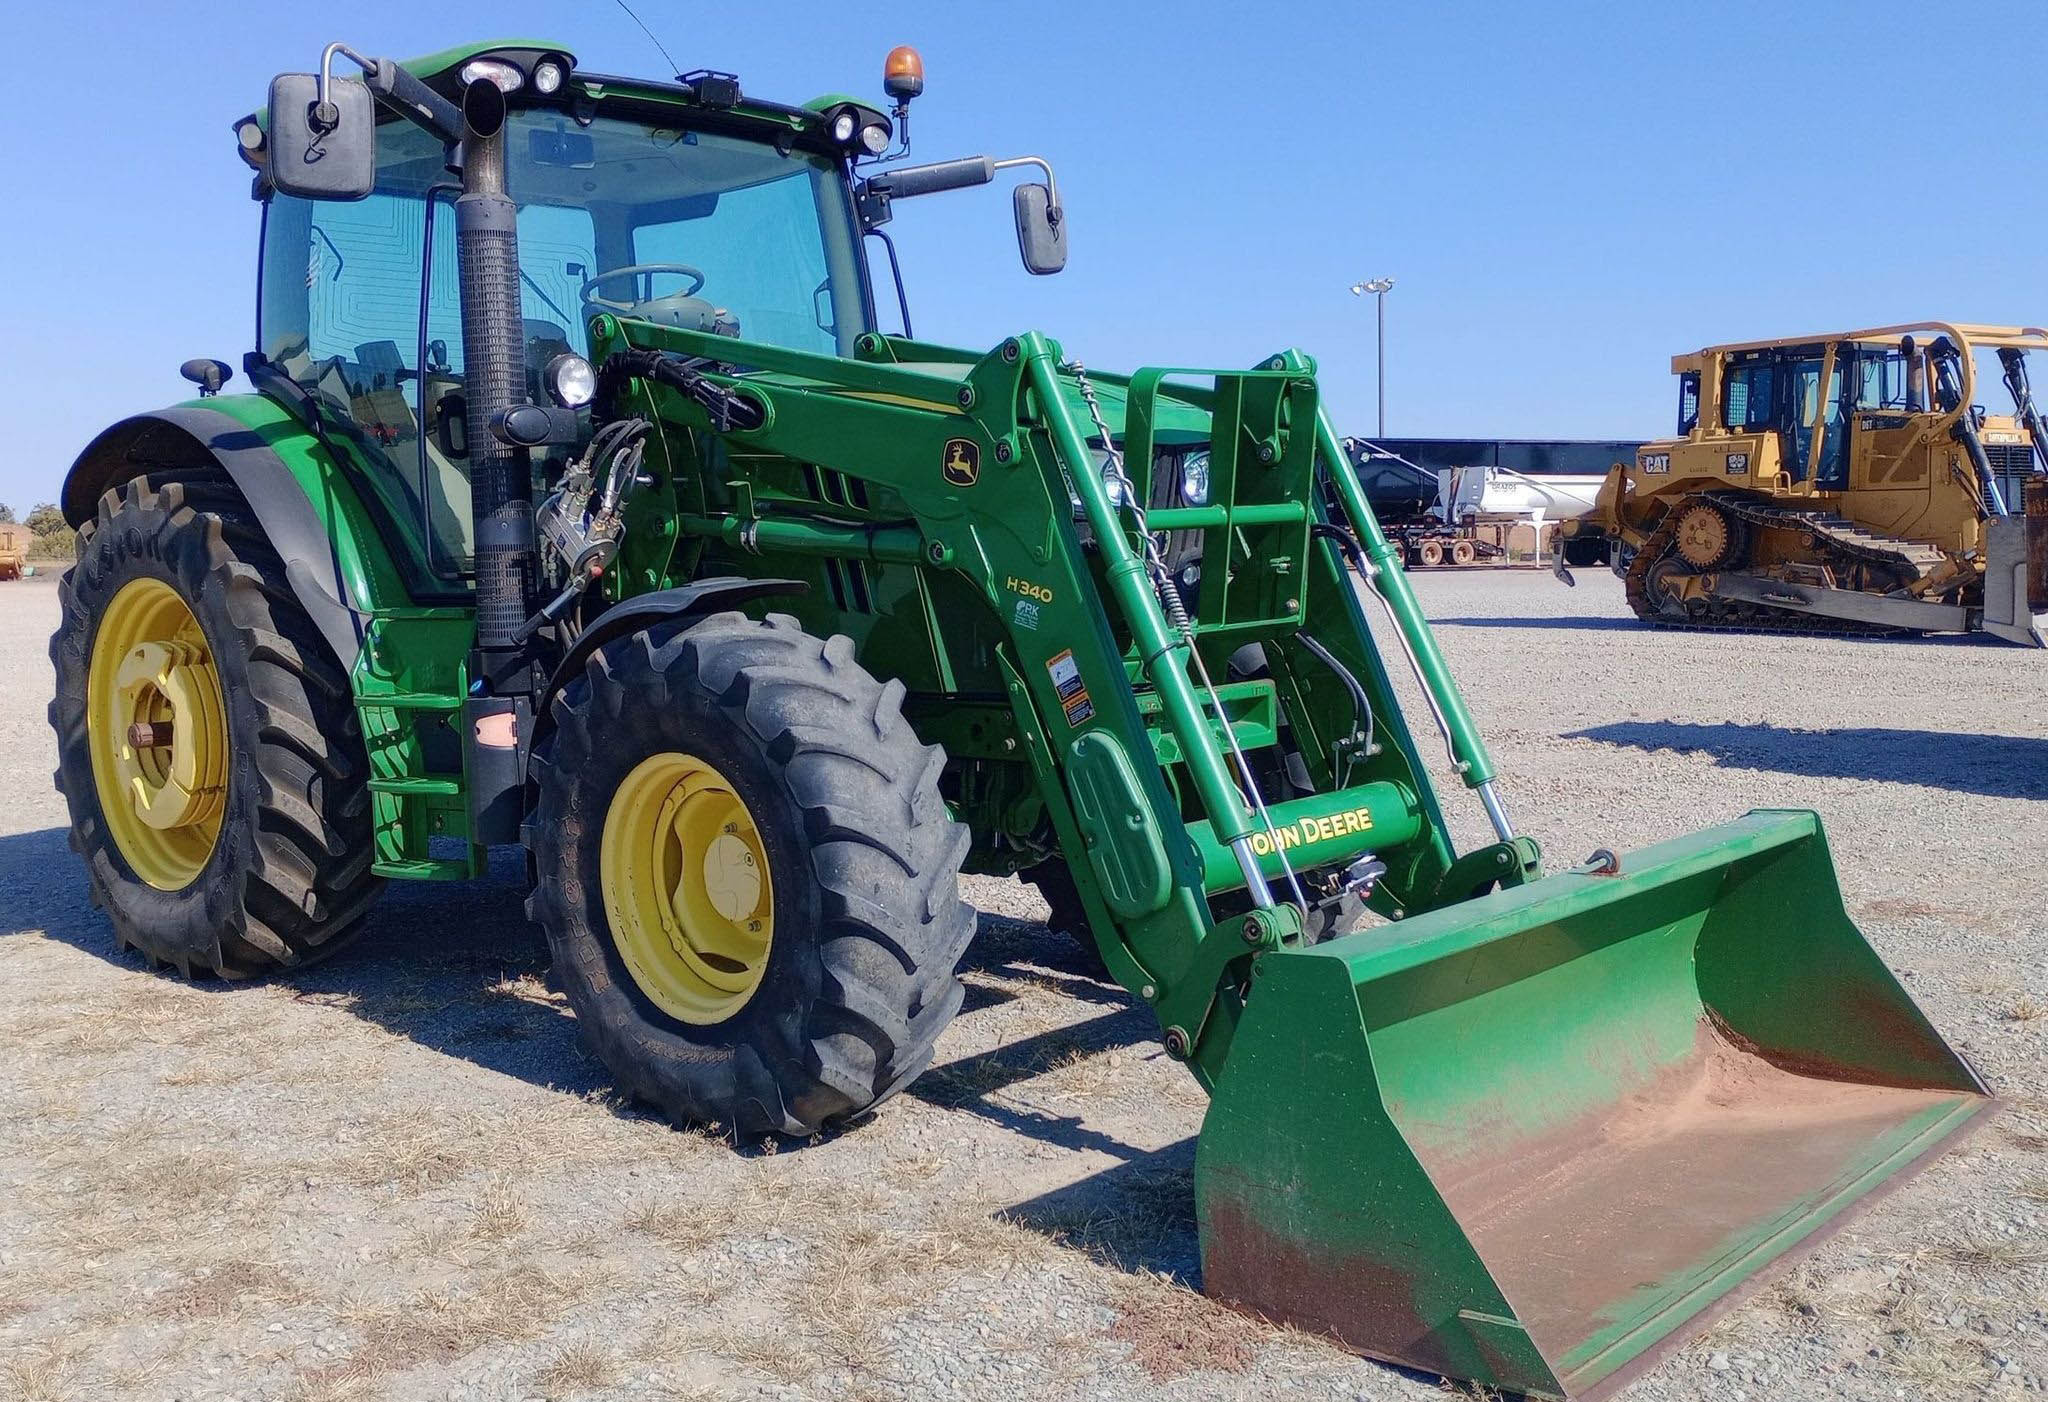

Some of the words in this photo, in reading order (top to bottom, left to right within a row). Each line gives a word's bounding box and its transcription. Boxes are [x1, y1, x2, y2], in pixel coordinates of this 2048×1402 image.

[1645, 455, 1670, 473] CAT
[1006, 576, 1053, 603] H340
[1298, 807, 1374, 845] DEERE
